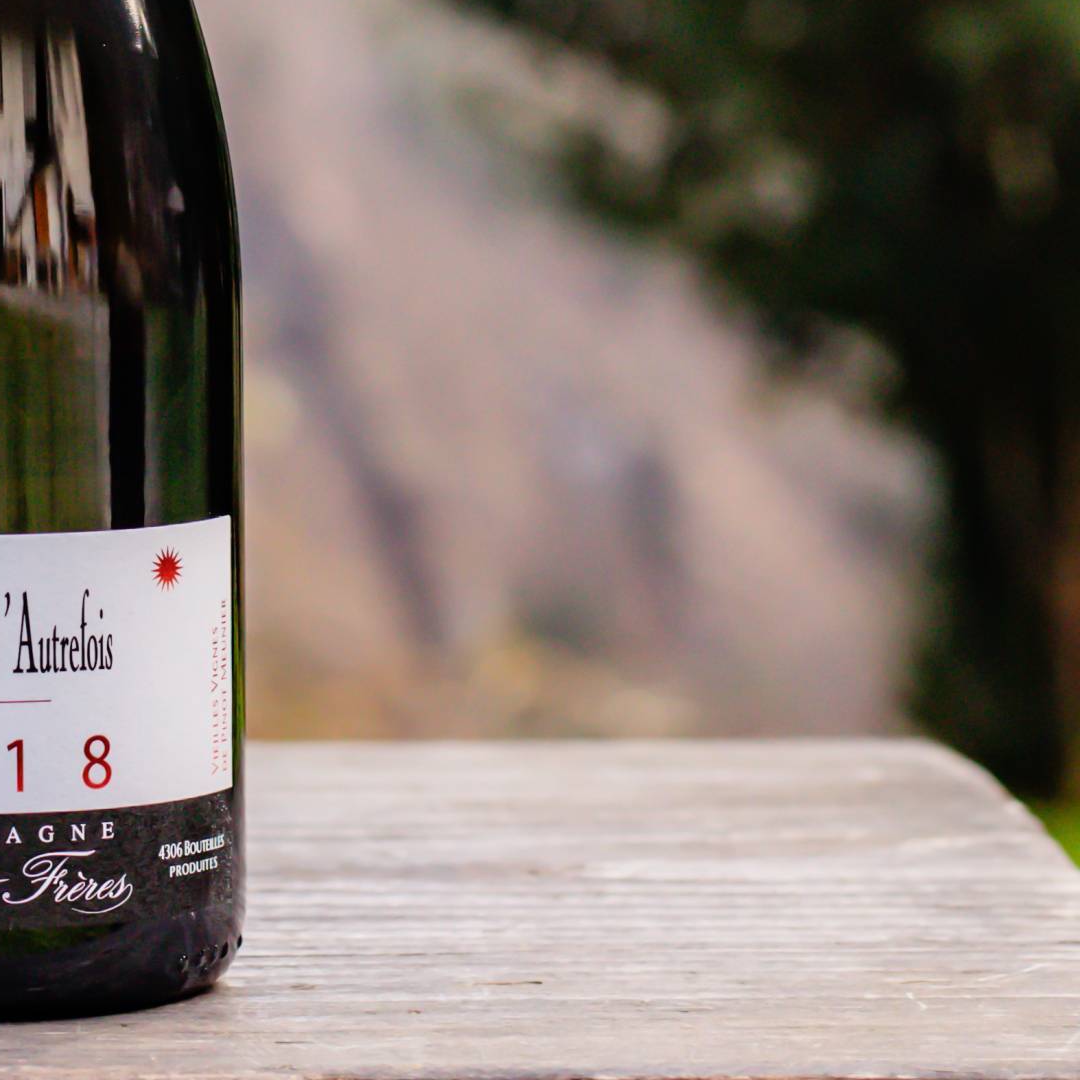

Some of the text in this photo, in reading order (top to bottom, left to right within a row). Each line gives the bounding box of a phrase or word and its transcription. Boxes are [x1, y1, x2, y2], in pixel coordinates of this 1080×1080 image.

[158, 833, 225, 861] 4306 BOUTEILLES
[169, 855, 219, 879] PRODUITES
[1, 849, 134, 915] Frères
